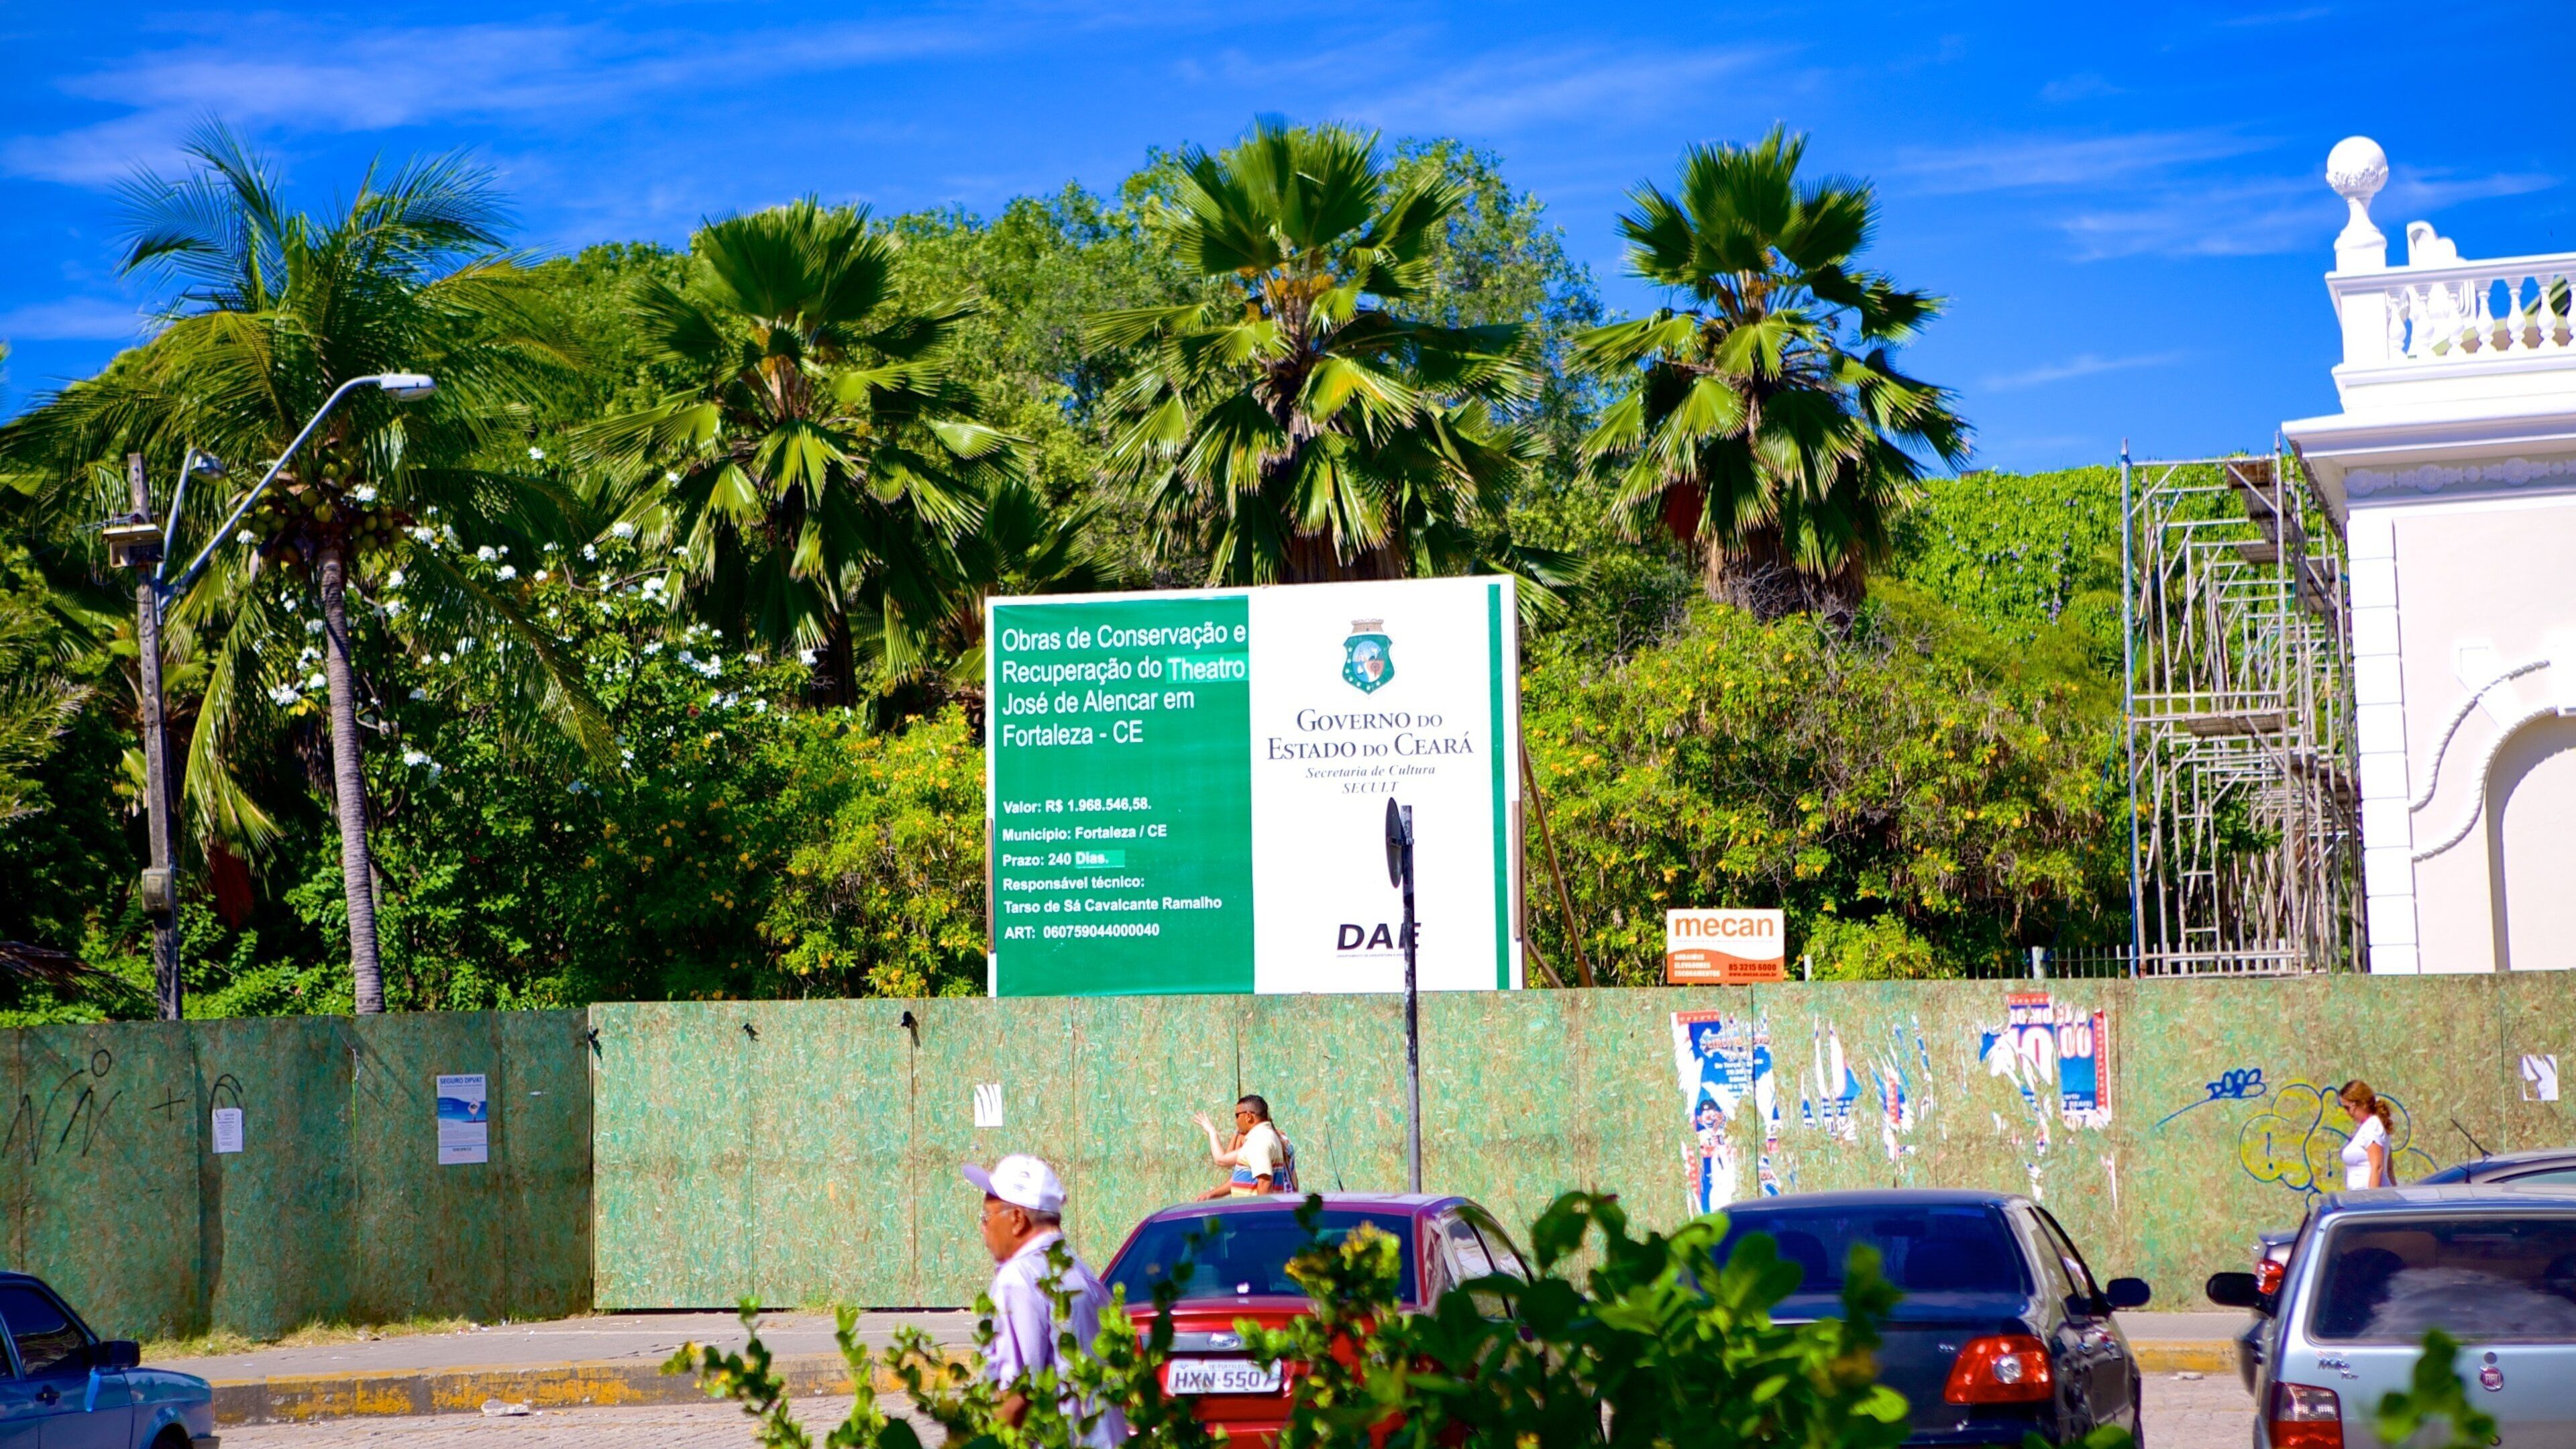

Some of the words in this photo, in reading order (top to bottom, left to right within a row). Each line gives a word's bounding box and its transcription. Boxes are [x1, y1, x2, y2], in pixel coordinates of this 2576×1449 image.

[1002, 628, 1061, 651] Obras
[1066, 626, 1091, 649] de
[1097, 621, 1228, 649] Conservação
[1233, 625, 1246, 643] e
[1002, 657, 1132, 686] Recuperação
[1137, 656, 1163, 678] do
[1168, 657, 1246, 681] Theatro
[1002, 692, 1048, 715] José
[1054, 692, 1079, 713] de
[1083, 690, 1158, 712] Alencar
[1163, 691, 1195, 709] em
[1297, 708, 1411, 732] GOVERNO
[1417, 714, 1443, 728] DO
[1003, 723, 1093, 747] Fortaleza
[1113, 720, 1143, 743] CE
[1267, 737, 1356, 760] ESTADO
[1362, 743, 1388, 757] DO
[1394, 731, 1474, 756] CEARÁ
[1305, 767, 1367, 779] Secretaria
[1371, 765, 1385, 777] de
[1389, 763, 1436, 776] Cultura
[1342, 781, 1399, 794] SECULT
[1003, 801, 1042, 814] Valor:
[1045, 799, 1063, 814] R$
[1067, 797, 1152, 812] 1.968.546,58.
[1002, 827, 1071, 843] Município:
[1075, 826, 1136, 840] Fortaleza
[1139, 825, 1144, 838] /
[1148, 824, 1167, 837] CE
[1002, 853, 1044, 867] Prazo:
[1048, 853, 1071, 865] 240
[1075, 851, 1109, 864] Dias.
[1003, 877, 1088, 893] Responsável
[1091, 876, 1144, 890] técnico:
[1004, 900, 1040, 914] Tarso
[1044, 900, 1060, 913] de
[1064, 898, 1081, 912] Sá
[1084, 898, 1159, 912] Cavalcante
[1162, 896, 1222, 910] Ramalho
[1004, 926, 1036, 939] ART:
[1675, 918, 1774, 936] mecan
